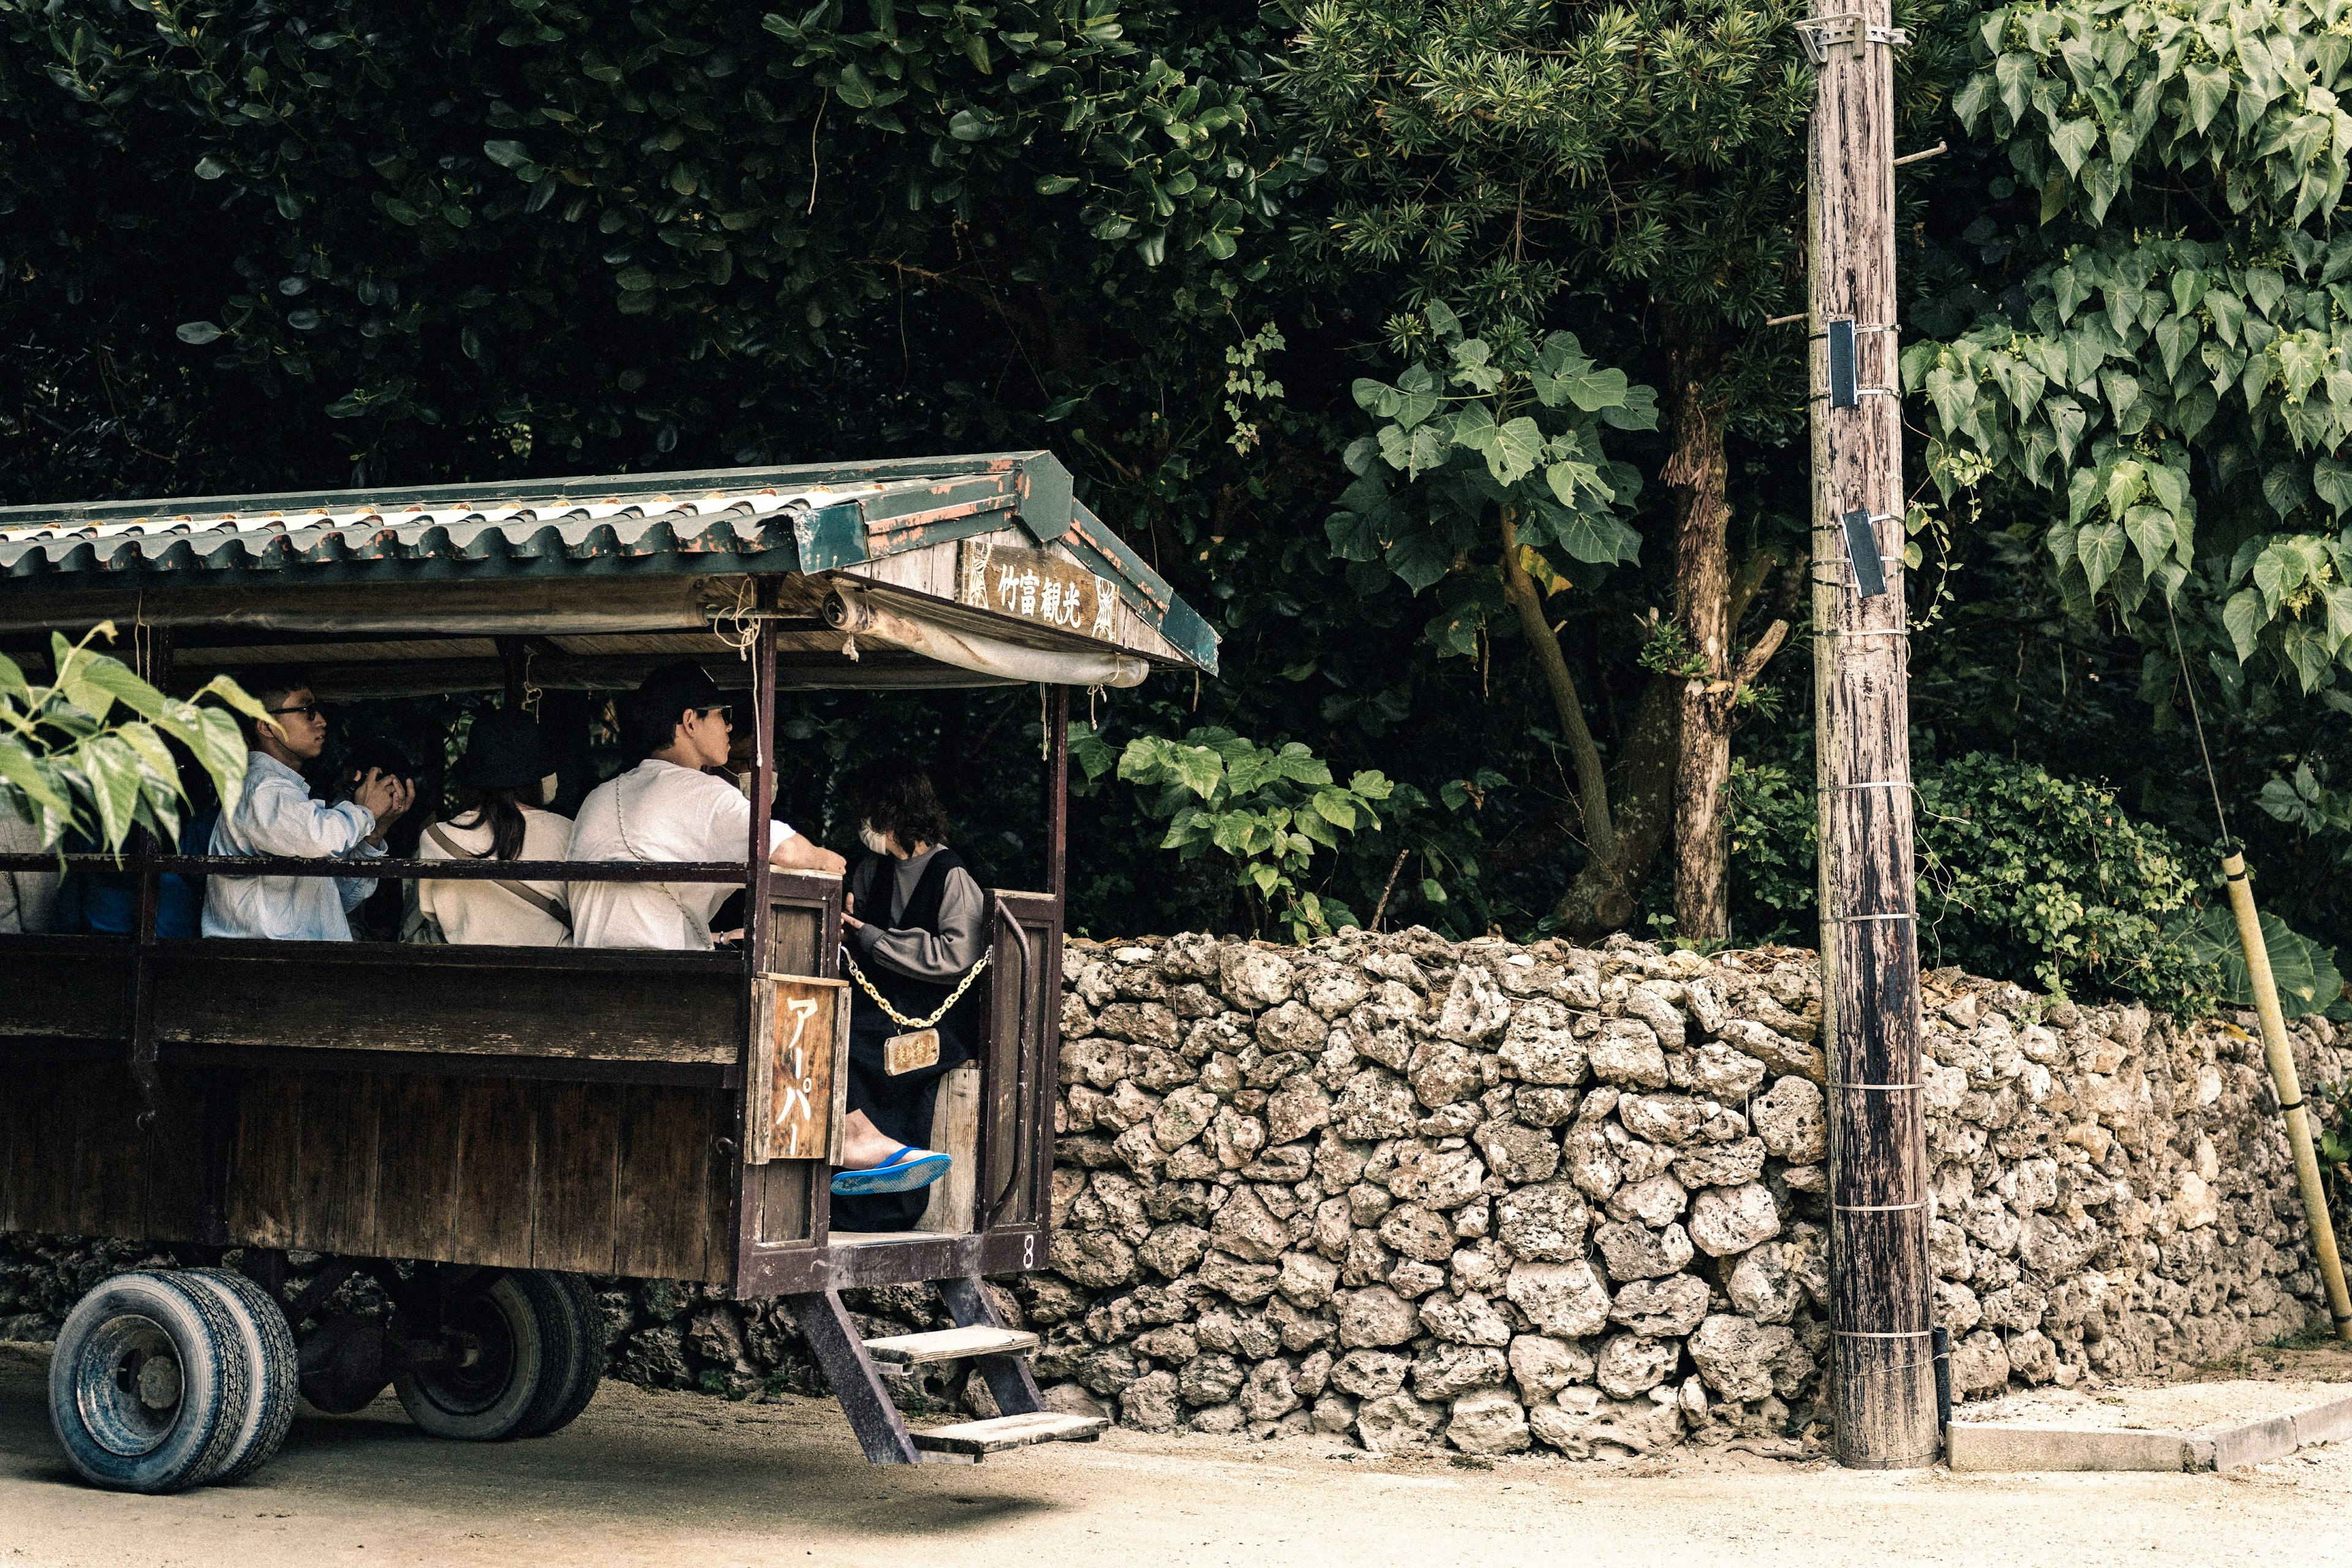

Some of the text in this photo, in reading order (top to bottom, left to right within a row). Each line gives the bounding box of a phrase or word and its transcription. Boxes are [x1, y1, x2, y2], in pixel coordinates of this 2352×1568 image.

[997, 564, 1081, 628] 竹富観光
[775, 997, 818, 1156] アーパー
[1023, 1234, 1035, 1269] 8
